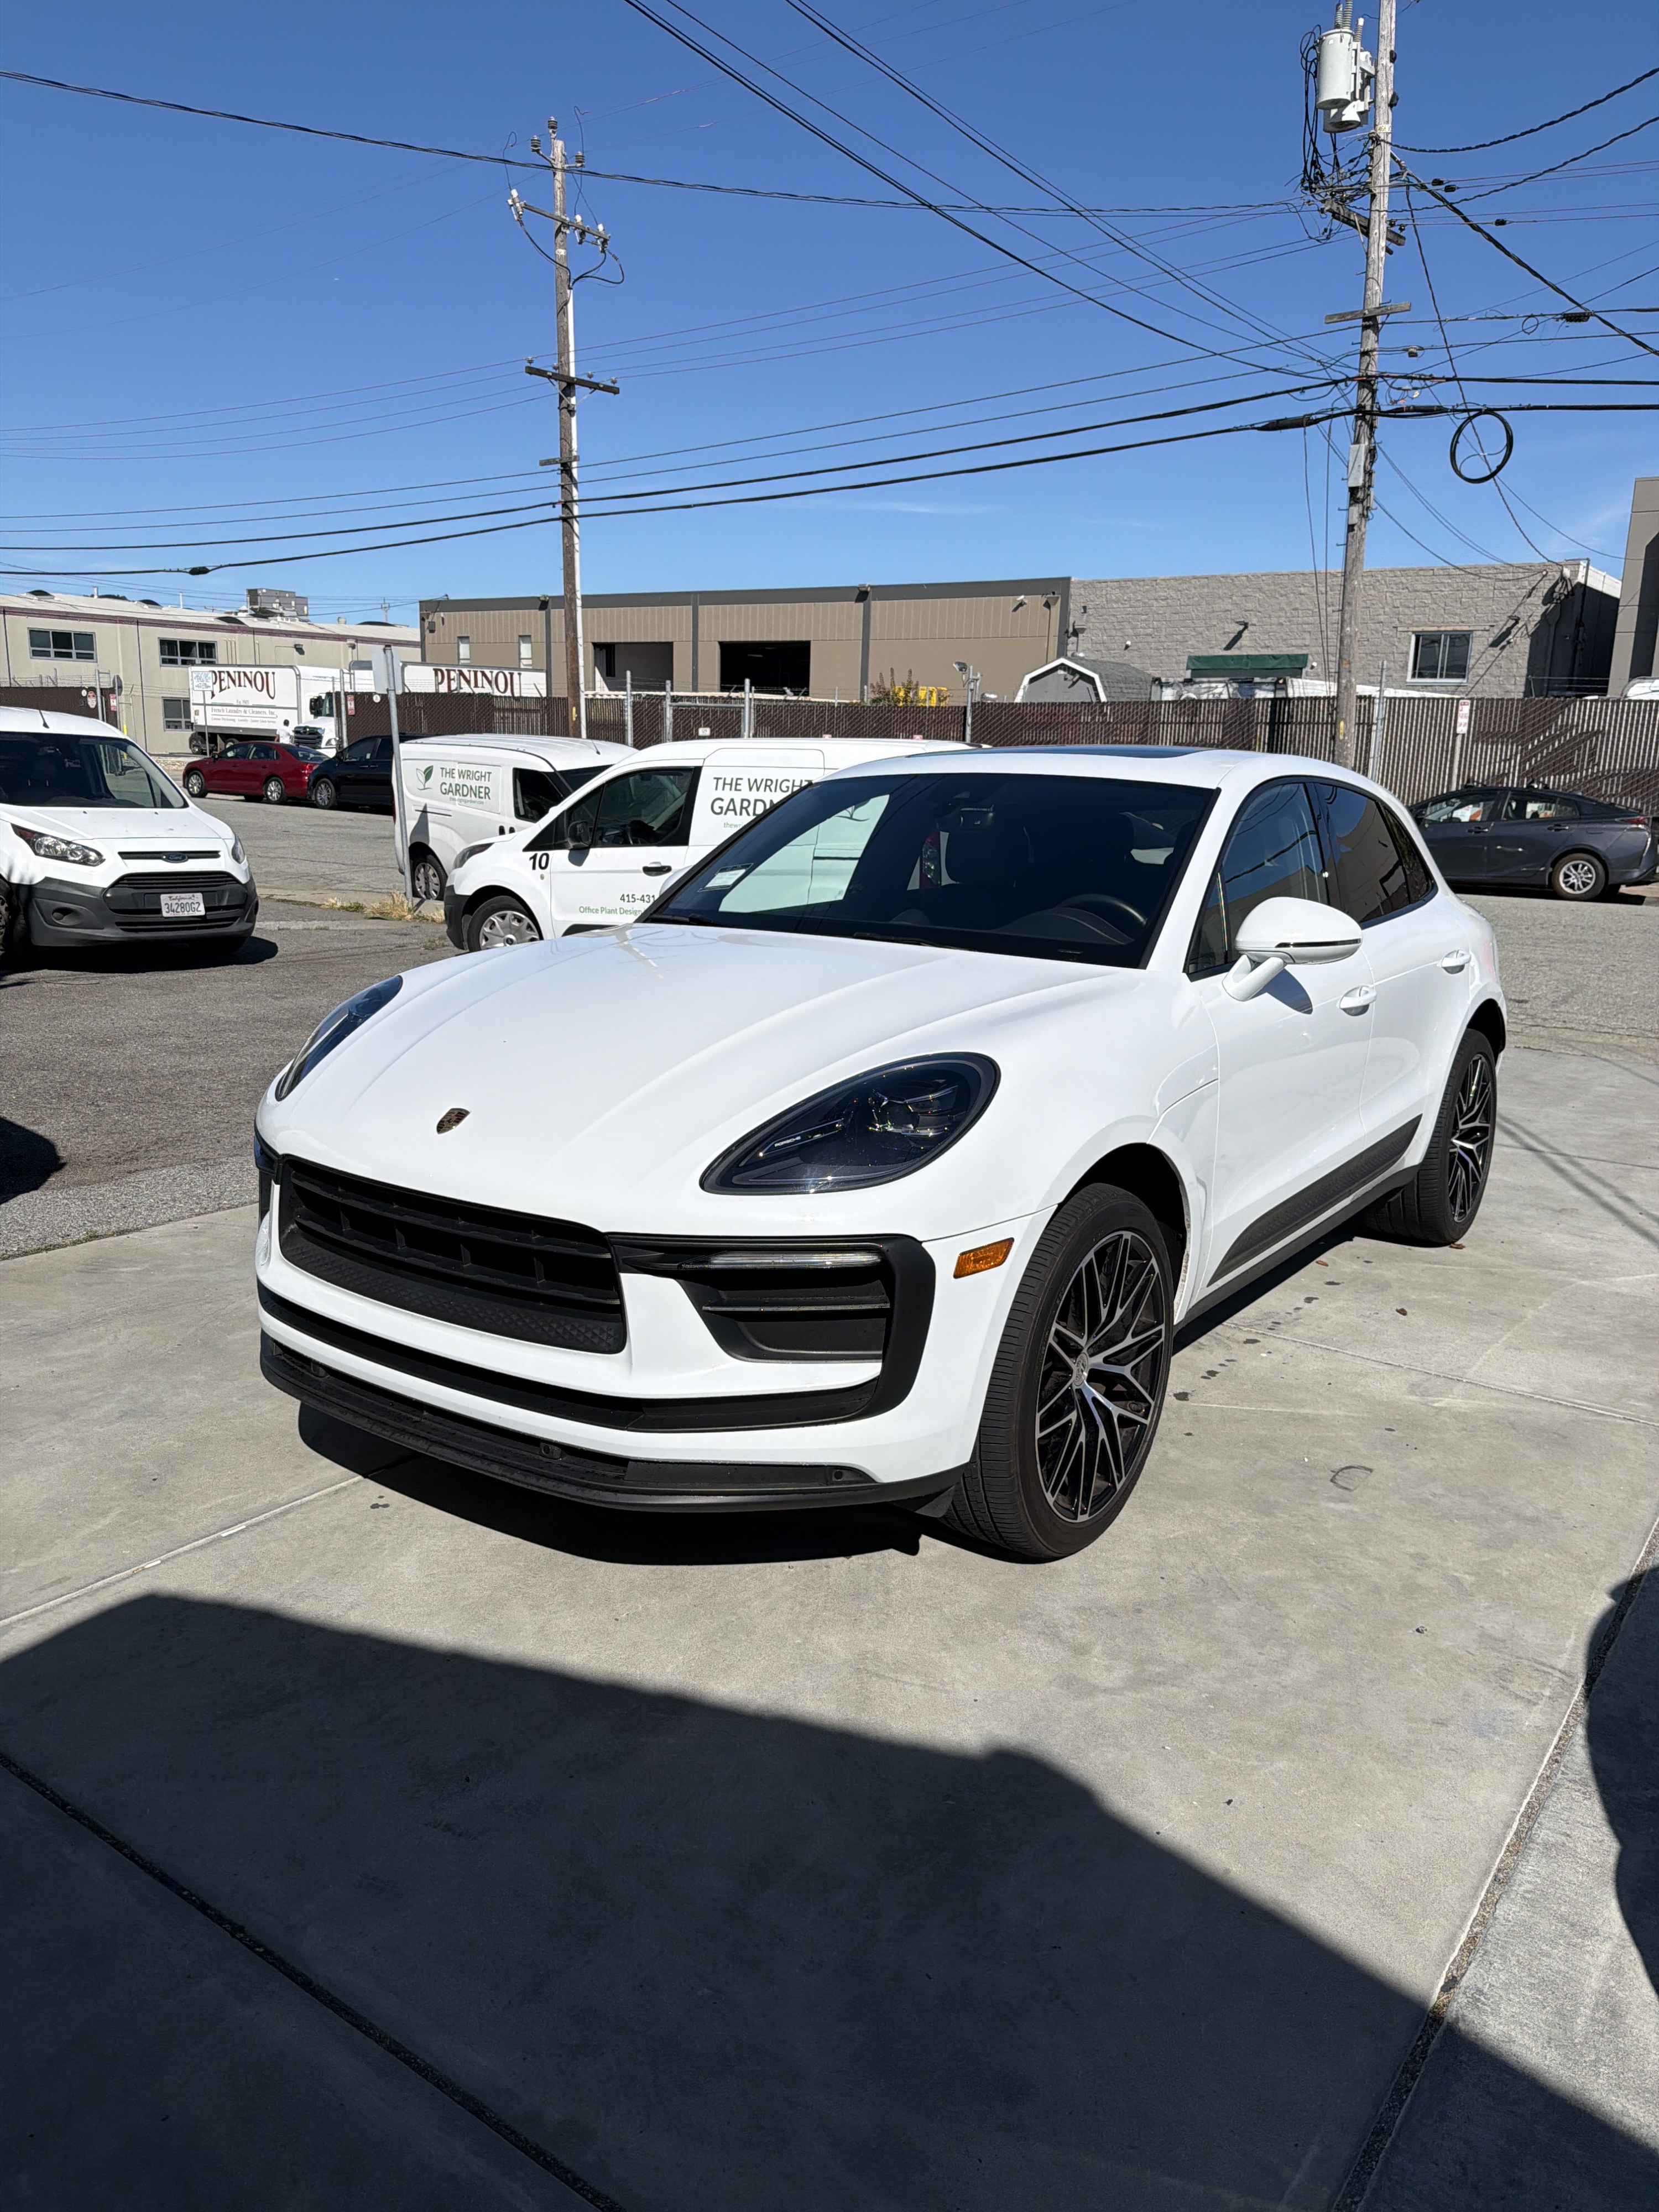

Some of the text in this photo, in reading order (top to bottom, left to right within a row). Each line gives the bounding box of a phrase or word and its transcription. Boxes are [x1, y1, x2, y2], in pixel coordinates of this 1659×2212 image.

[208, 670, 276, 700] PENINOU
[433, 668, 521, 698] PENINOU
[440, 767, 492, 782] THE WRIGHT
[440, 782, 491, 800] GARDNER
[713, 777, 743, 792] THE
[711, 797, 776, 817] GARD
[529, 852, 550, 870] 10
[620, 893, 655, 904] 415-431
[164, 902, 202, 914] 34280G2
[579, 906, 642, 917] Office Plant Design
